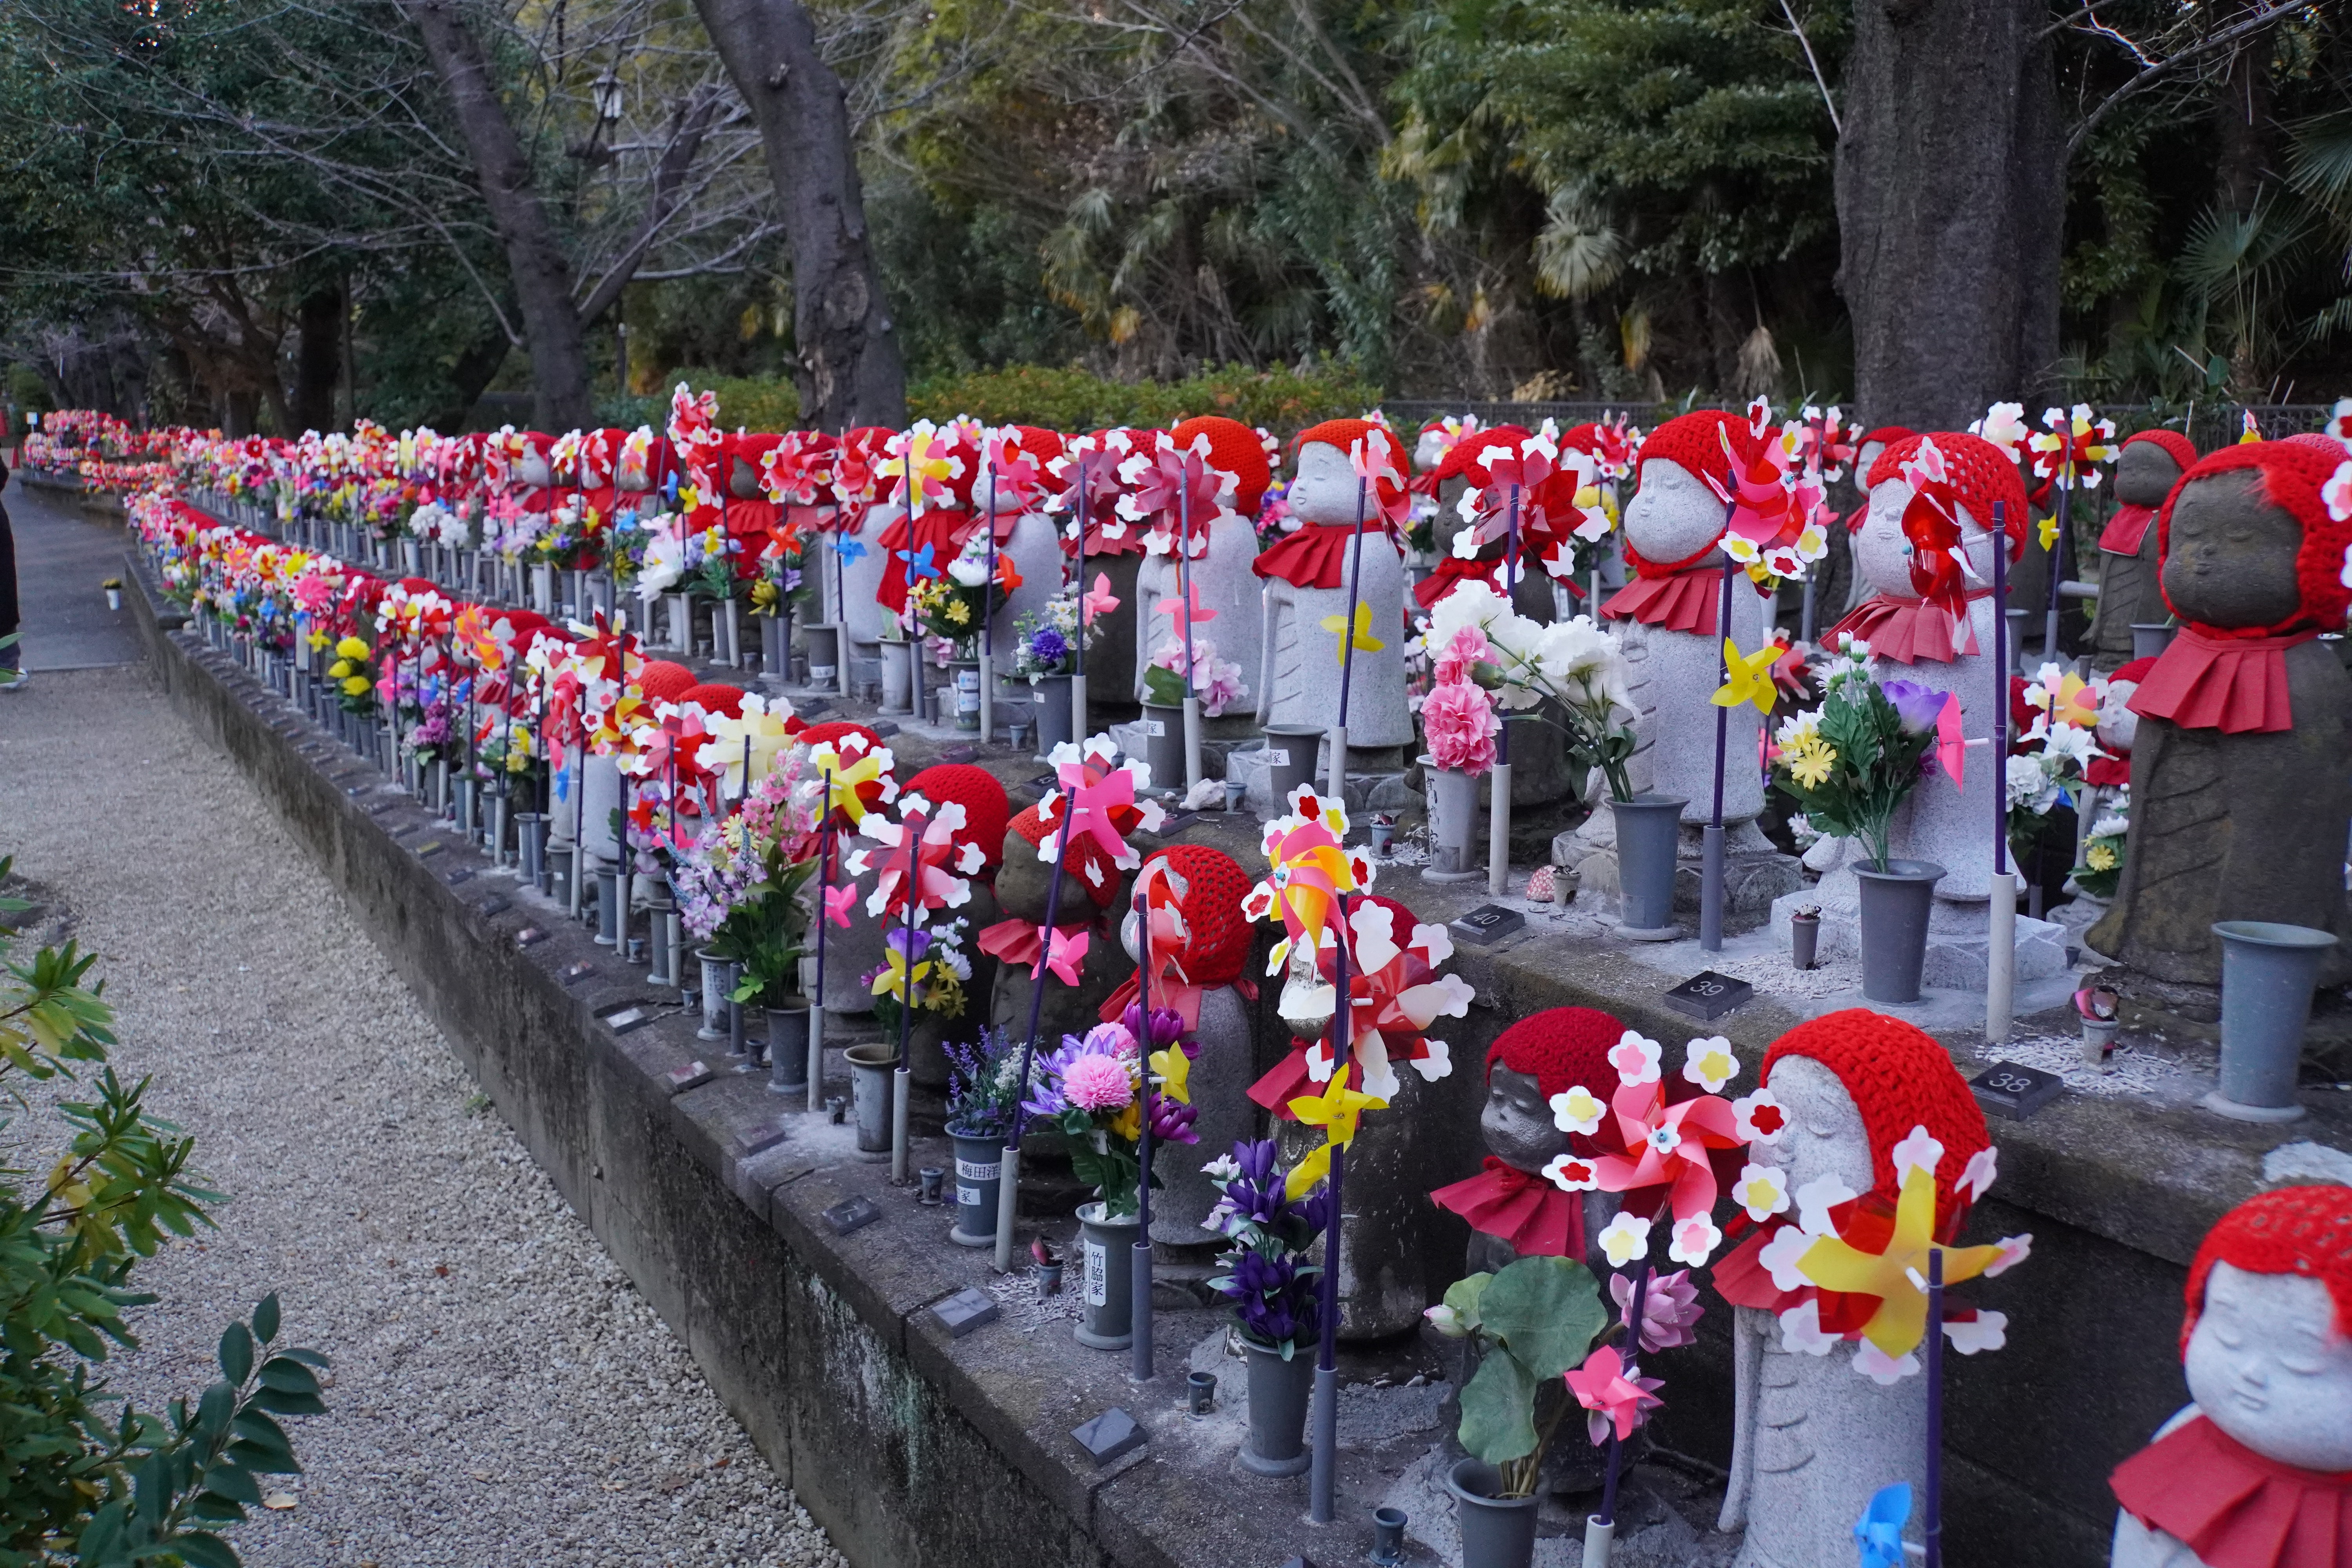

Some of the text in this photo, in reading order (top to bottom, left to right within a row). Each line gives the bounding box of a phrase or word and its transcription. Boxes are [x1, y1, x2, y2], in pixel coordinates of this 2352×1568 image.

[1473, 913, 1500, 925] 40
[1690, 981, 1724, 996] 39
[1989, 1073, 2031, 1092] 38
[962, 1163, 1001, 1179] 梅田洋
[1091, 1252, 1103, 1296] 竹脇家
